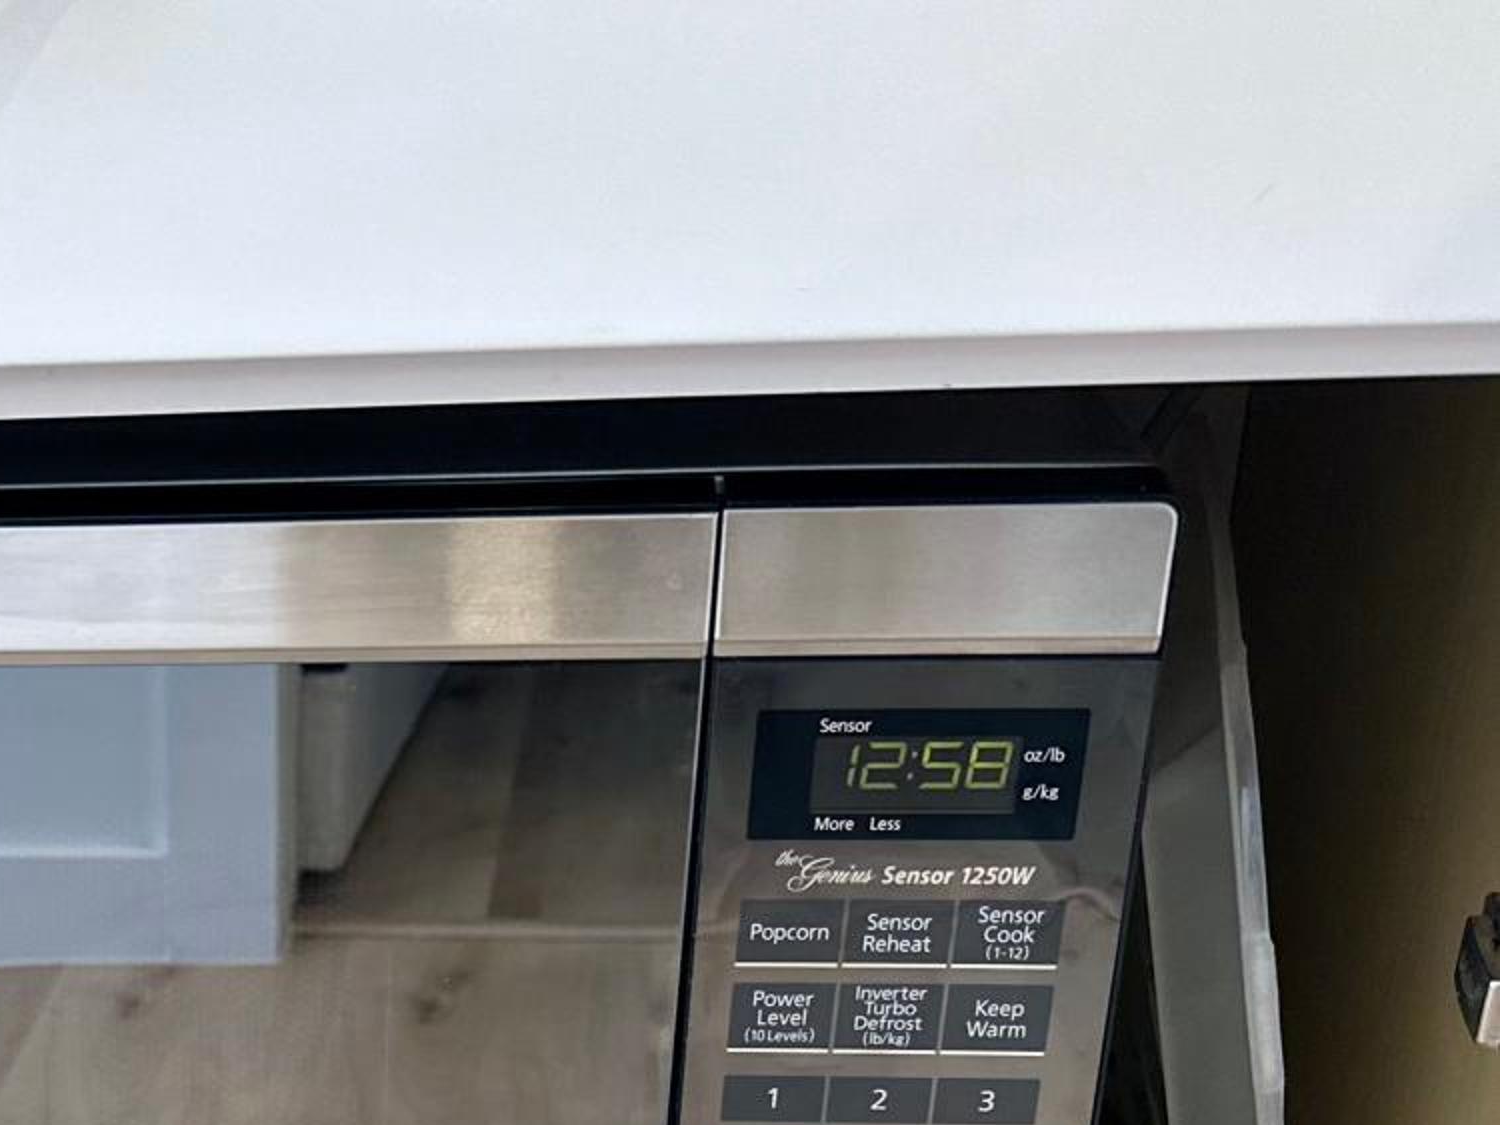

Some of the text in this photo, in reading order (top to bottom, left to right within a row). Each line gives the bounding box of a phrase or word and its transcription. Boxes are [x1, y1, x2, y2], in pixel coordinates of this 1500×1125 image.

[819, 718, 872, 734] Sensor
[1023, 747, 1066, 764] oz/lb
[845, 741, 1014, 790] 12:58
[1021, 784, 1060, 801] g/kg
[813, 816, 901, 832] More Less
[775, 849, 1037, 893] the Genius Sensor 1250W
[866, 914, 932, 932] Sensor
[978, 906, 1045, 925] Sensor
[749, 924, 830, 945] Popcorn
[983, 926, 1035, 944] Cook
[863, 936, 931, 954] Reheat
[985, 946, 1030, 961] (1-12)
[752, 990, 815, 1008] Power
[855, 985, 928, 1001] Inverter
[864, 1001, 918, 1016] Turbo
[974, 999, 1026, 1023] Keep
[757, 1009, 808, 1027] Level
[853, 1016, 924, 1031] Defrost
[744, 1028, 816, 1044] (10 Levels)
[862, 1031, 911, 1047] (lb/kg)
[966, 1020, 1027, 1040] Warm
[767, 1087, 779, 1109] 1
[869, 1088, 888, 1111] 2
[977, 1089, 996, 1113] 3
